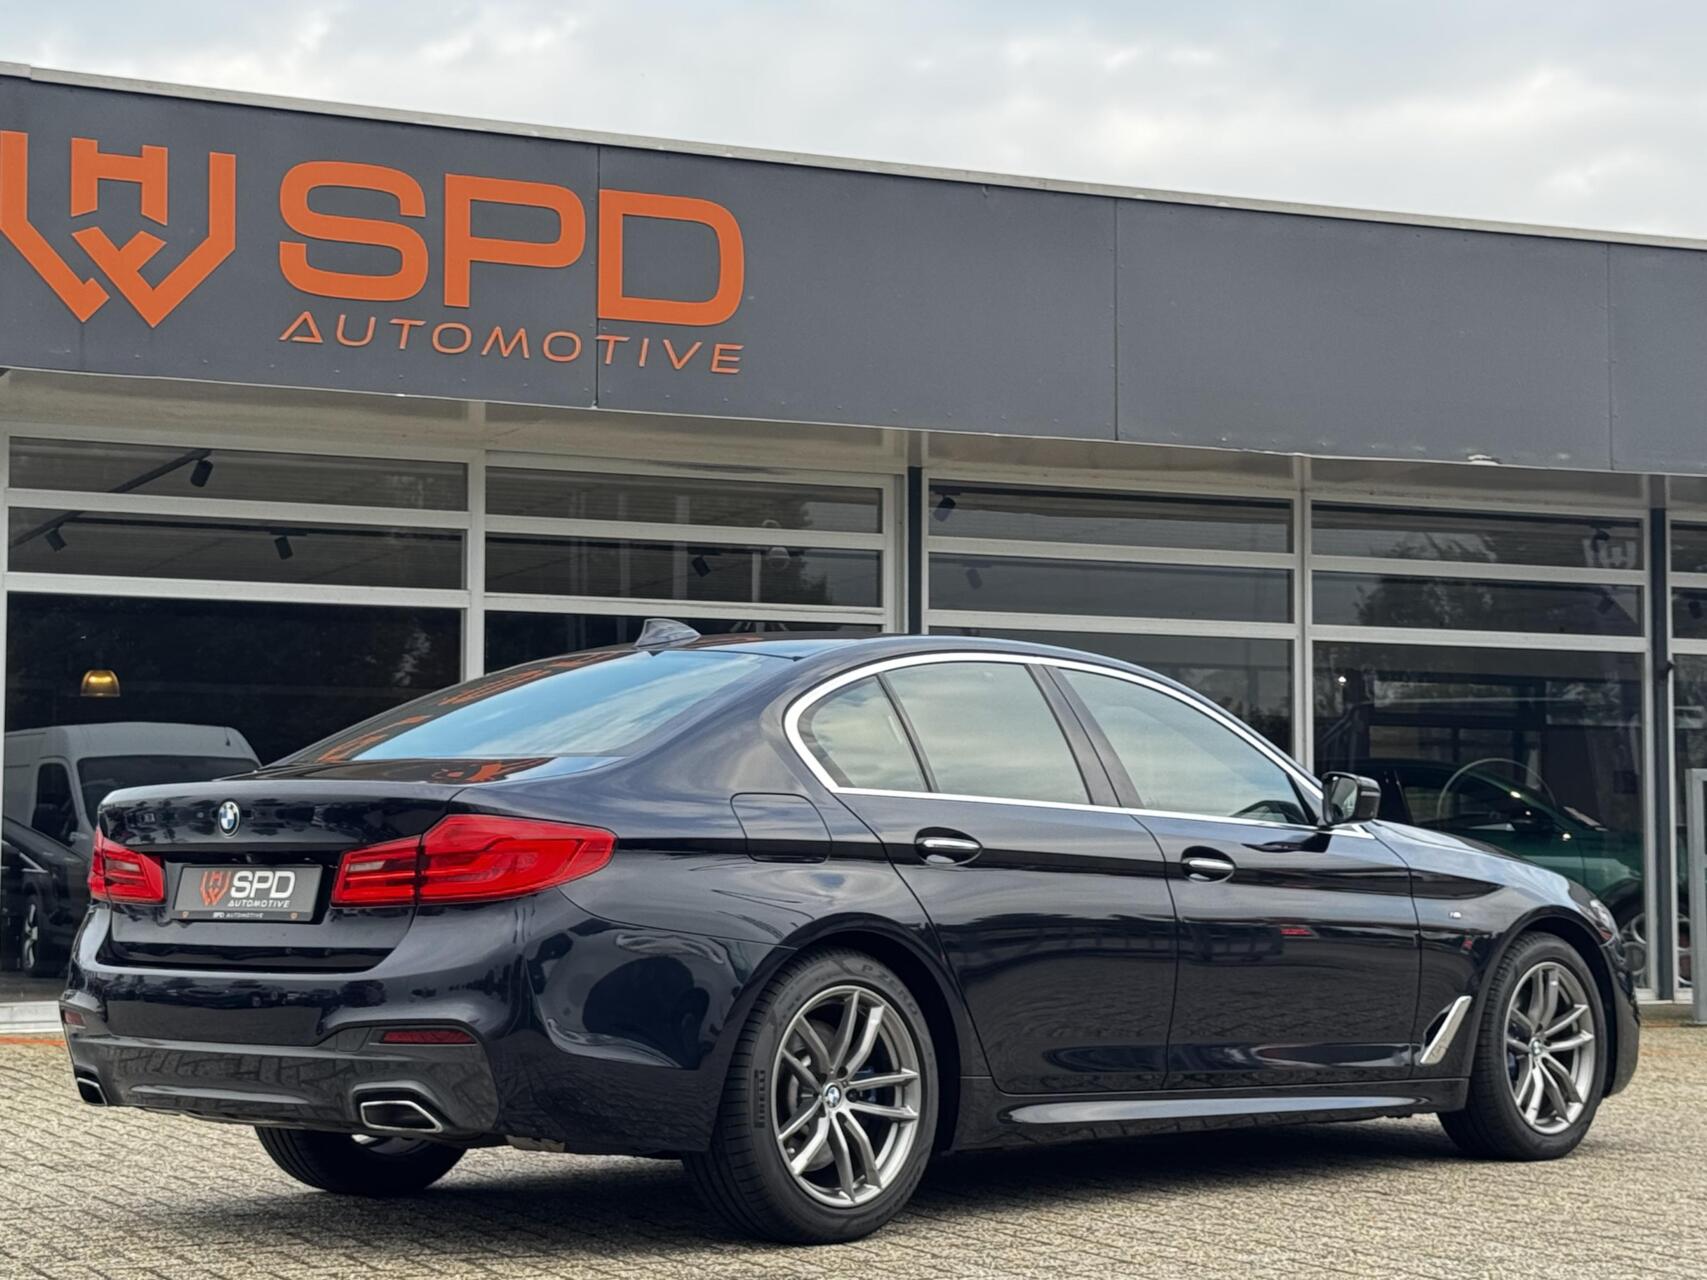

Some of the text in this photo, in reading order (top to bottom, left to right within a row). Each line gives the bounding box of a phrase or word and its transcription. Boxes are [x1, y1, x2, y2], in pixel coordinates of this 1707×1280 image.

[279, 160, 744, 327] SPD
[279, 311, 744, 373] AUTOMOTIVE
[227, 900, 291, 908] AUTOMOTIVE
[230, 870, 296, 898] SPD
